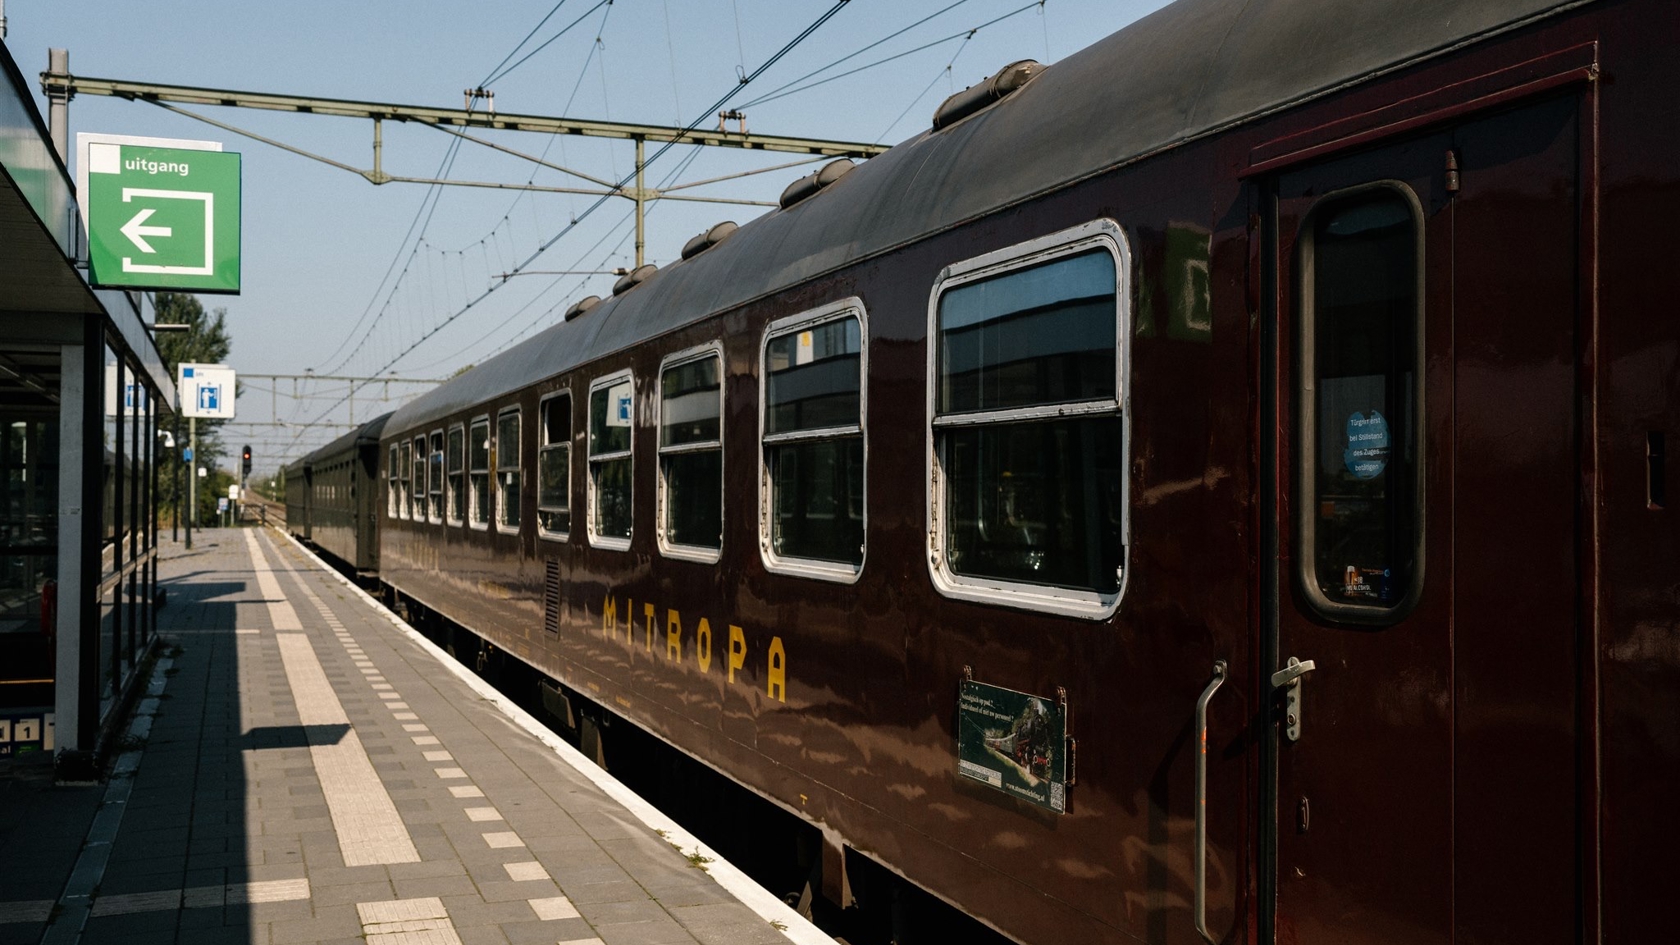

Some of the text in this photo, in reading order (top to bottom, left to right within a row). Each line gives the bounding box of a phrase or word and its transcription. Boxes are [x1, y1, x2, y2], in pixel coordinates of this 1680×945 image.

[125, 157, 189, 176] uitgang
[1370, 417, 1381, 425] erst
[1358, 432, 1383, 441] Stillstand
[1363, 448, 1380, 456] Zuges
[603, 594, 786, 704] MITROPA
[23, 726, 30, 739] 1
